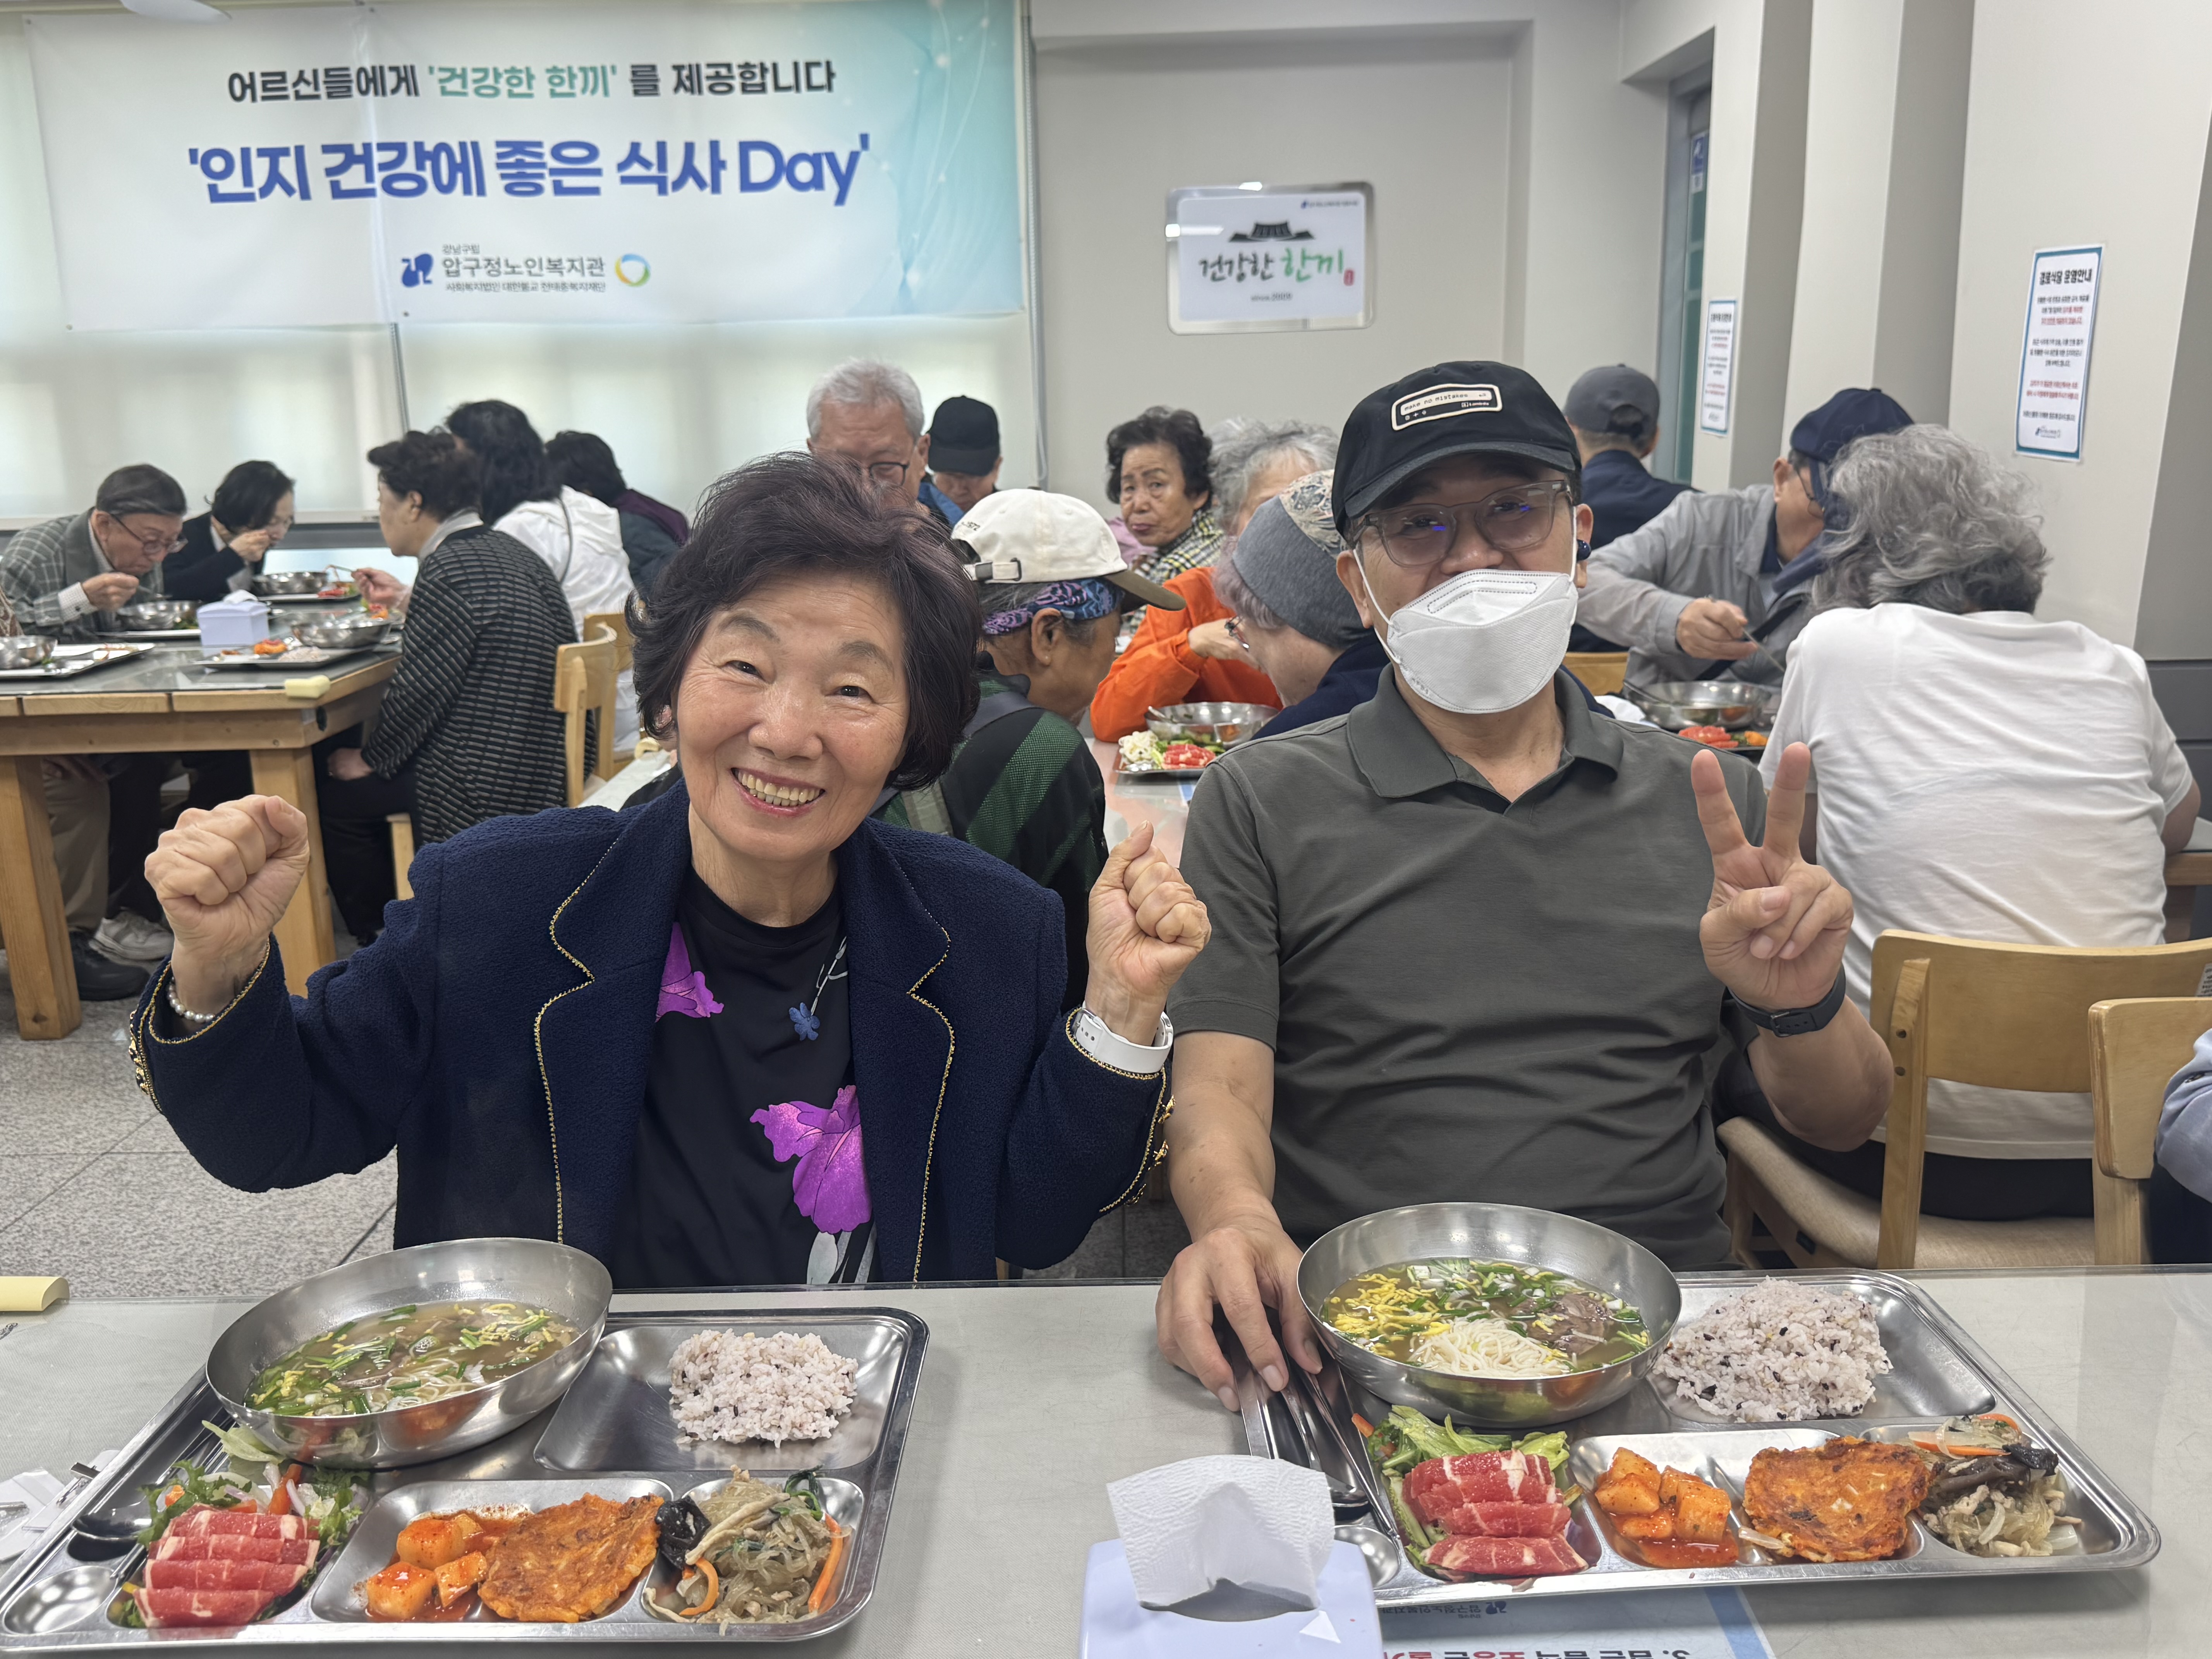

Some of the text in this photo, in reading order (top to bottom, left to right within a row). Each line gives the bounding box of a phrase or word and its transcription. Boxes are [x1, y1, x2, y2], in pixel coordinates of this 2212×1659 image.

[228, 60, 836, 103] 어르신들에게 '건강한 한끼' 를 제공합니다
[189, 132, 870, 206] '인지 건강에 좋은 식사 Day'
[442, 244, 480, 255] 강남구립
[442, 256, 605, 277] 압구정노인복지관
[1199, 252, 1275, 283] 건강한
[1279, 247, 1344, 283] 한끼
[1405, 402, 1420, 411] make
